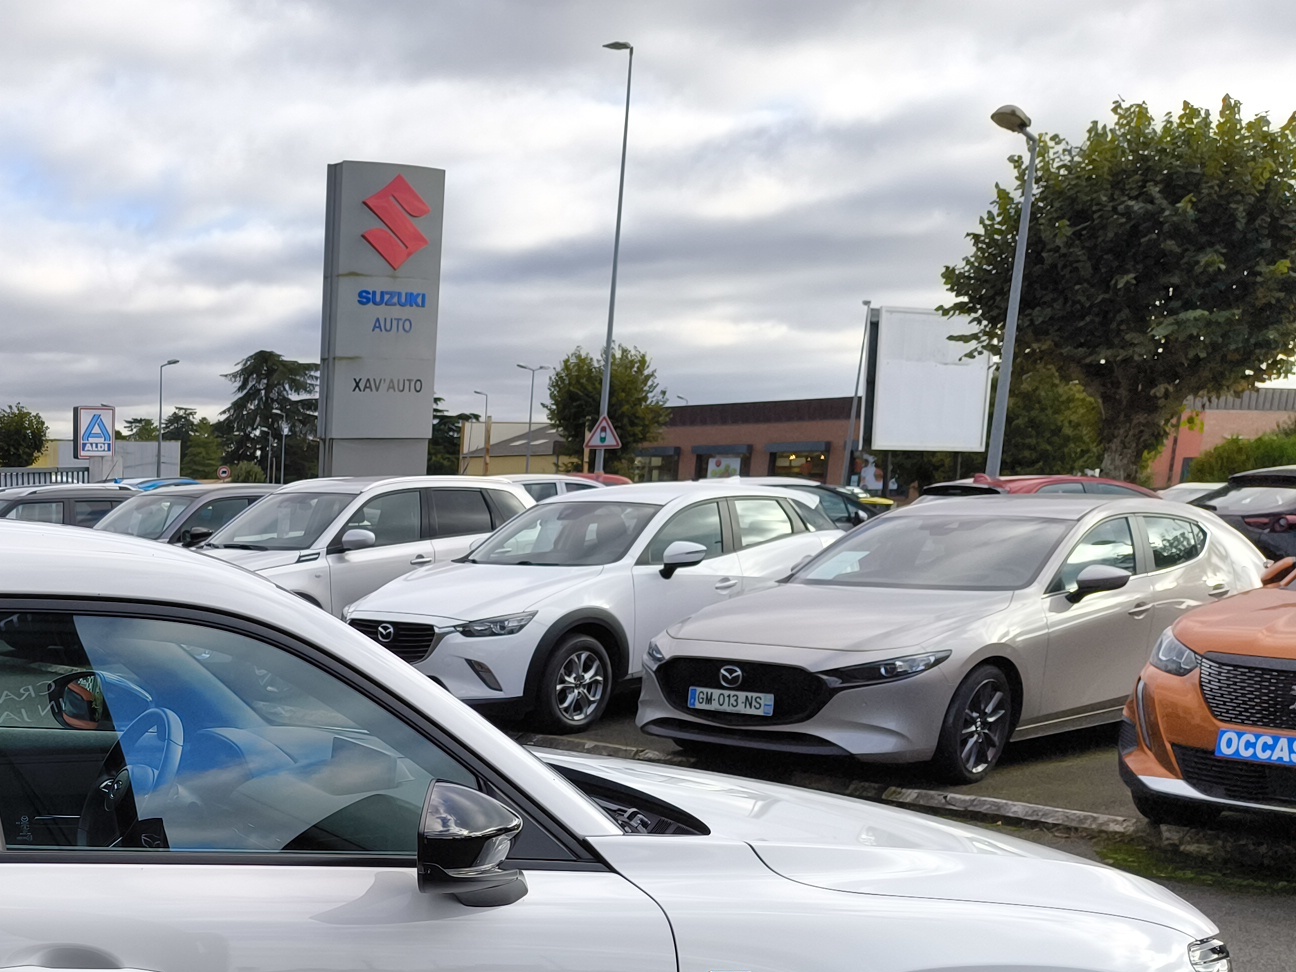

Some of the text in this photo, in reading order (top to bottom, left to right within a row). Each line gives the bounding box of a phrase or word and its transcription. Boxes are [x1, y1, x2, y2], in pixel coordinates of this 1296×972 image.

[357, 289, 427, 308] SUZUKI
[371, 317, 412, 333] AUTO
[352, 378, 423, 393] XAV'AUTO
[84, 443, 108, 451] ALDI
